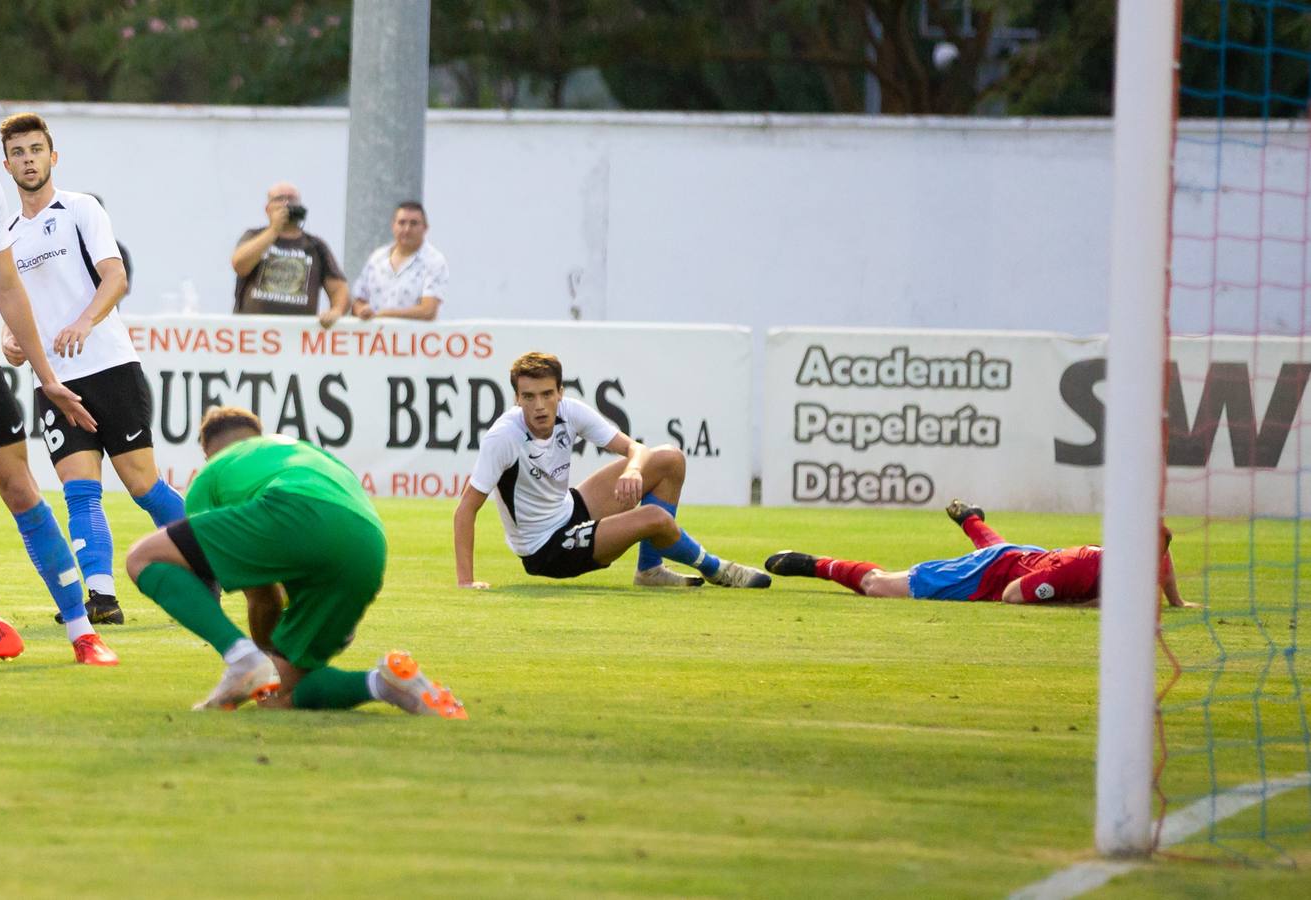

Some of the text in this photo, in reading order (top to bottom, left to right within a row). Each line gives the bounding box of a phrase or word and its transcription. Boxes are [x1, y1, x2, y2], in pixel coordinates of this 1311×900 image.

[129, 326, 495, 359] ENVASES METÁLICOS
[795, 345, 1012, 389] Academia
[667, 418, 720, 457] S.A.
[794, 402, 1001, 452] Papelería
[793, 462, 934, 504] Diseño
